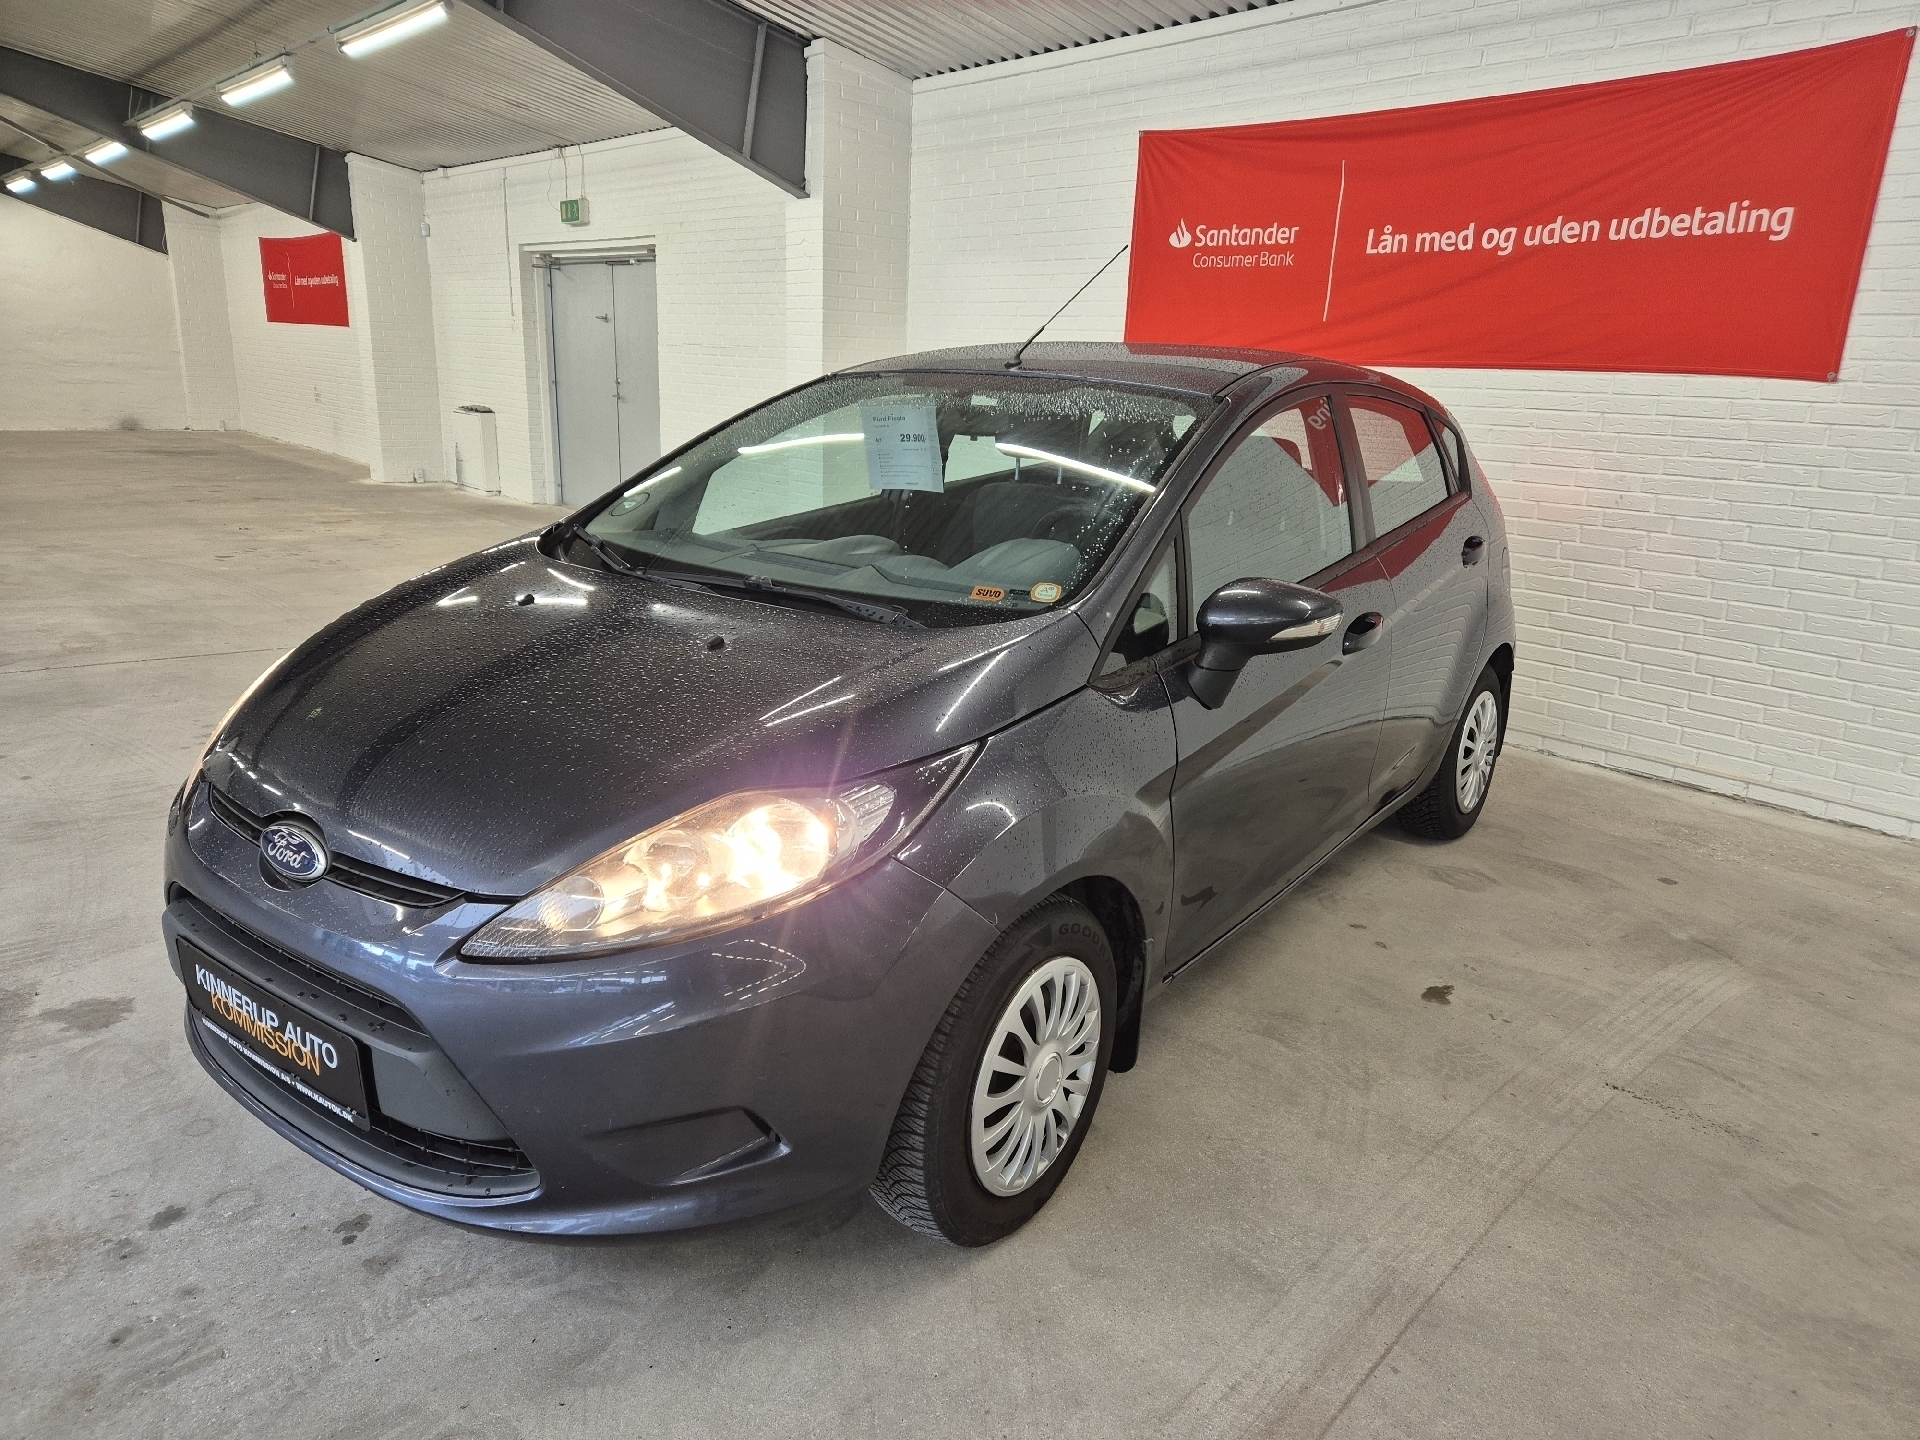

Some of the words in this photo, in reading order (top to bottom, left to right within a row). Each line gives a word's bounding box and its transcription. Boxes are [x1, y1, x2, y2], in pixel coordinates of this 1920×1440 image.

[1194, 222, 1299, 248] Santander
[1366, 225, 1408, 254] Lån
[1415, 222, 1475, 252] med
[1481, 227, 1517, 256] og
[1523, 215, 1600, 247] uden
[1608, 200, 1796, 242] udbetaling
[1192, 252, 1259, 268] Consumer
[1259, 251, 1295, 267] Bank
[267, 831, 310, 868] Ford
[195, 963, 279, 1030] KINNERUP
[284, 1021, 338, 1069] AUTO
[210, 991, 320, 1076] KOMMISSION
